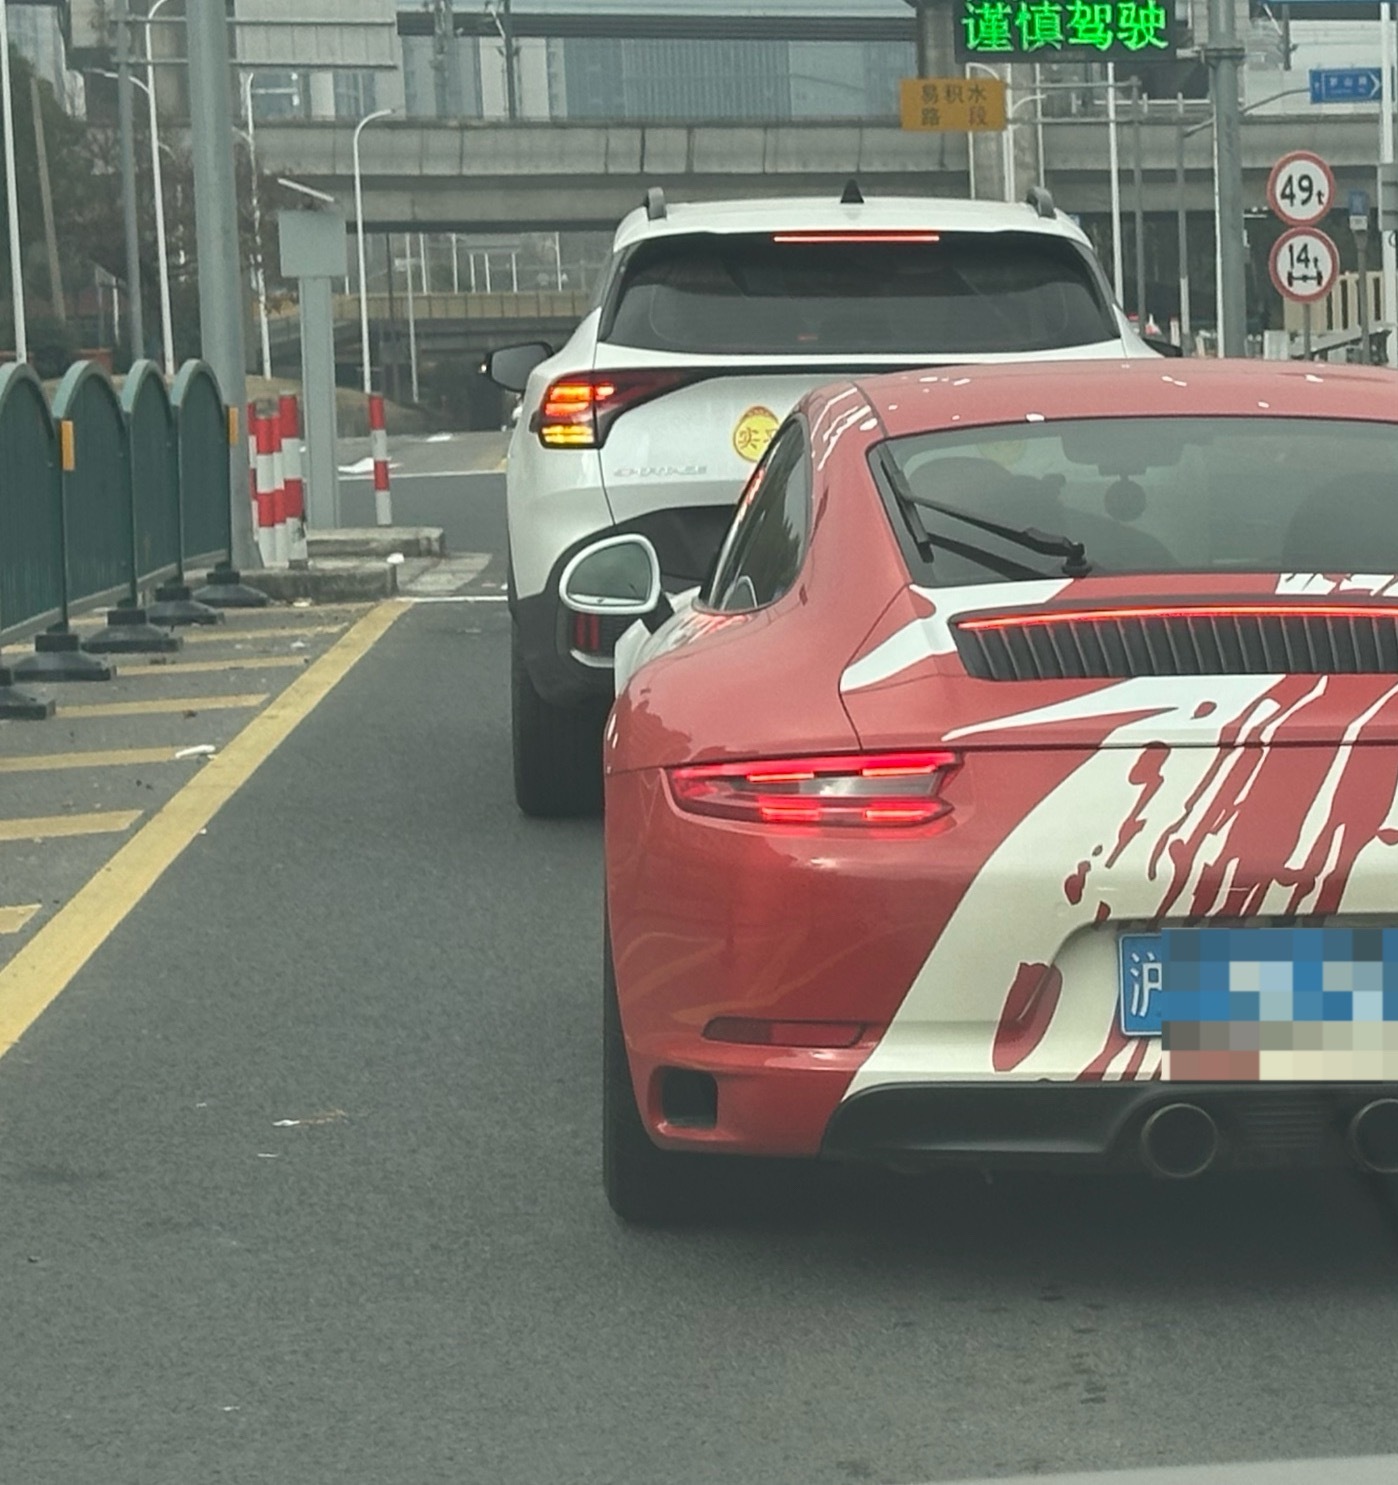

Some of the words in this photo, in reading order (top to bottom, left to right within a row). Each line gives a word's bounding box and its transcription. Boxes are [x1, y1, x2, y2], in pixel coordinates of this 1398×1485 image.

[961, 0, 1169, 51] 谨慎驾驶
[922, 84, 987, 104] 易积水
[1280, 174, 1325, 207] 49t
